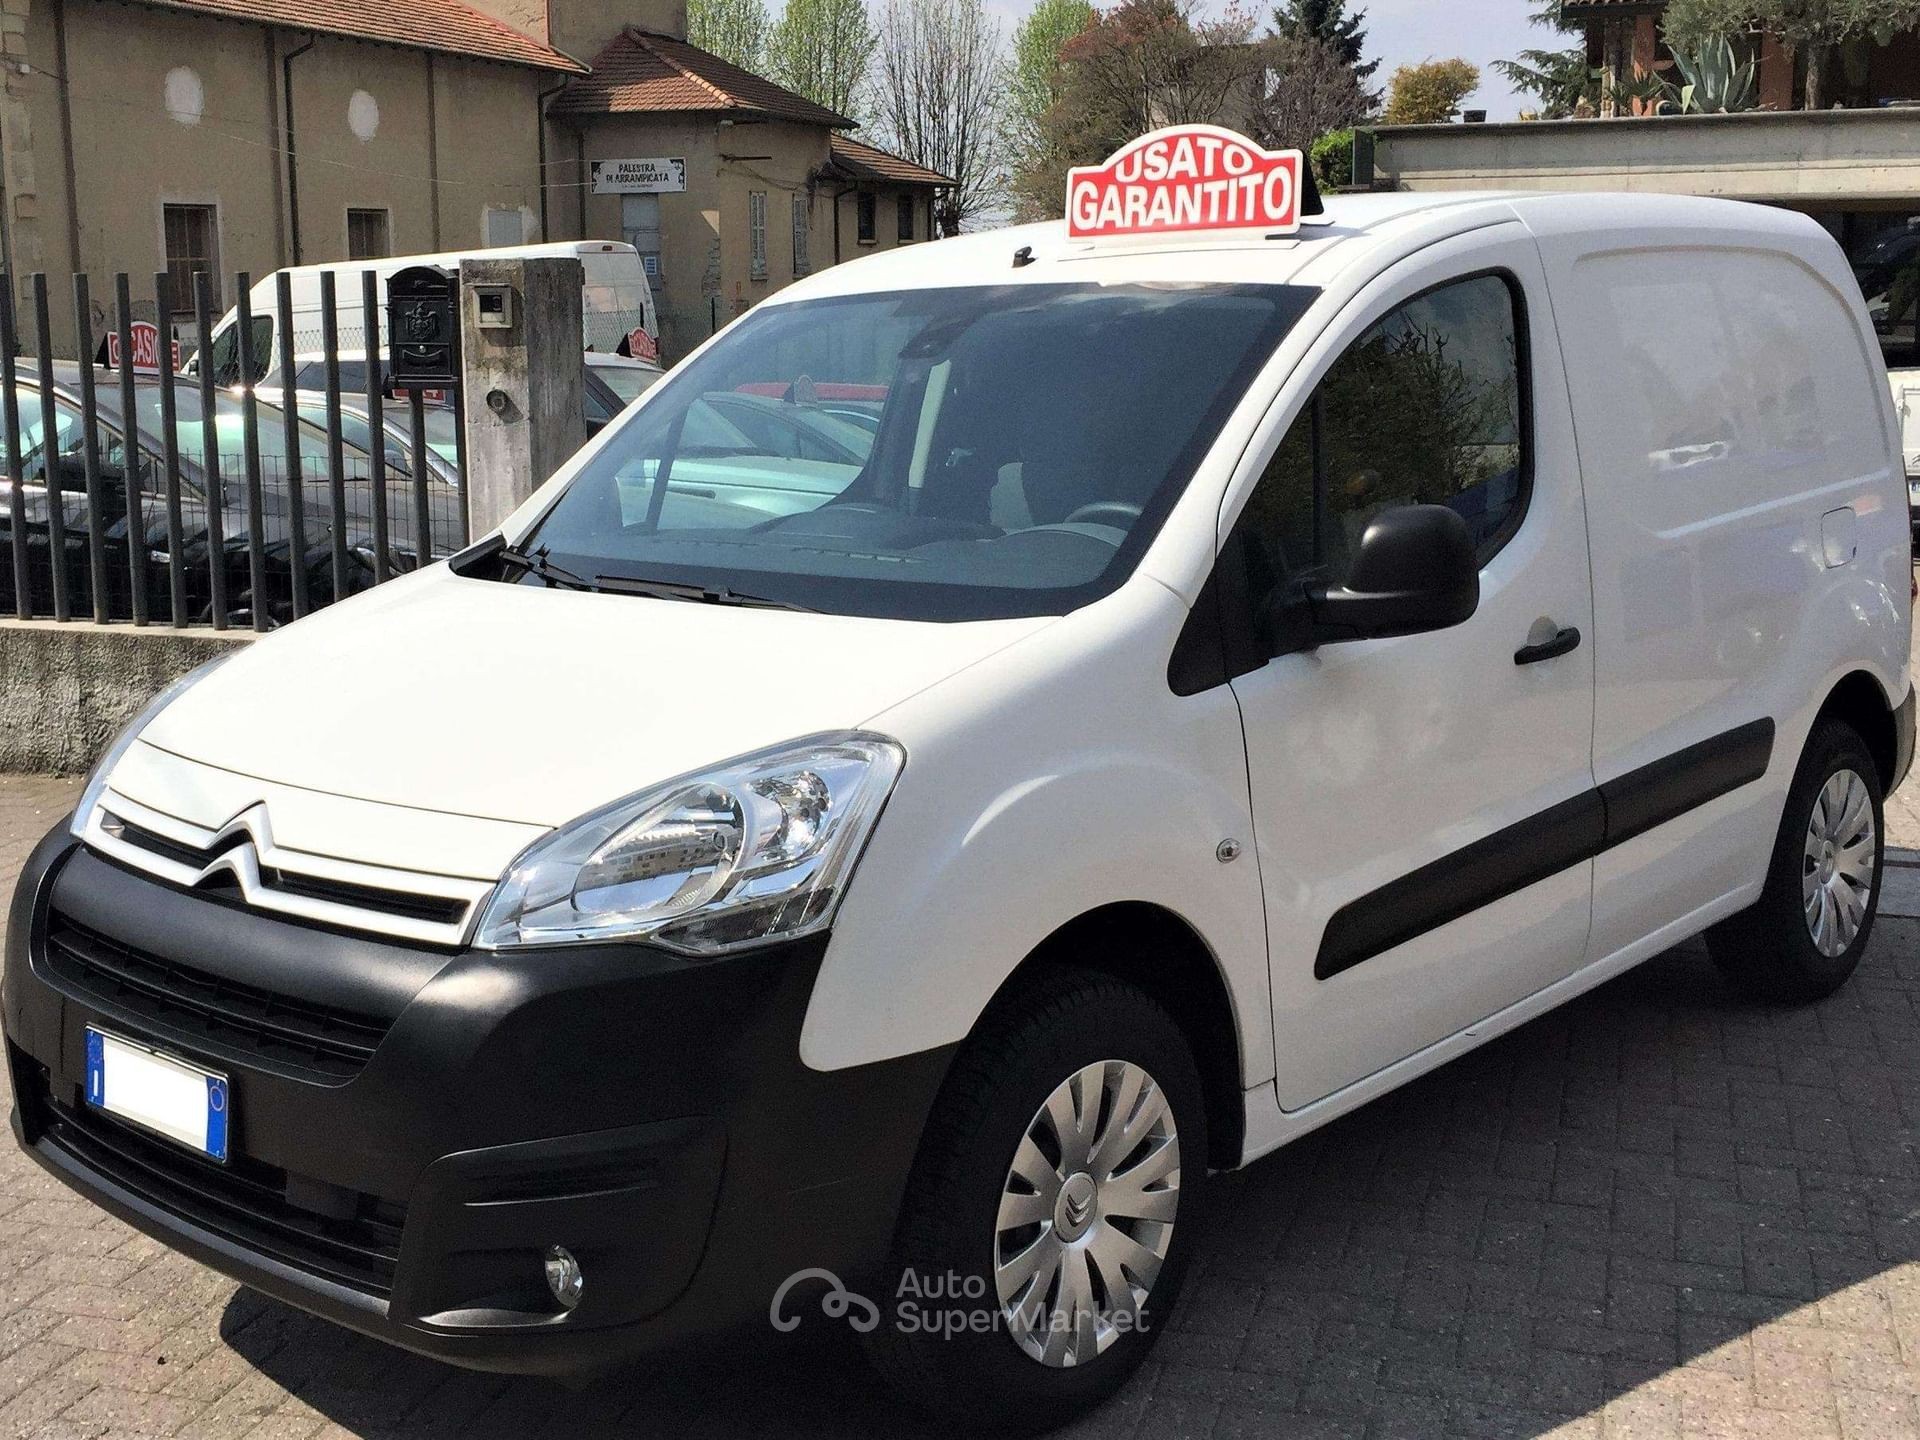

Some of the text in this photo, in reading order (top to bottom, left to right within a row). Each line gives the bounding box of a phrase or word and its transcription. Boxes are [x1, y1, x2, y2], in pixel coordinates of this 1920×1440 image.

[618, 163, 656, 173] PALESTRA
[1115, 136, 1254, 183] USATO
[606, 173, 669, 183] DI ARRAMPICATA
[1072, 165, 1292, 231] GARANTITO
